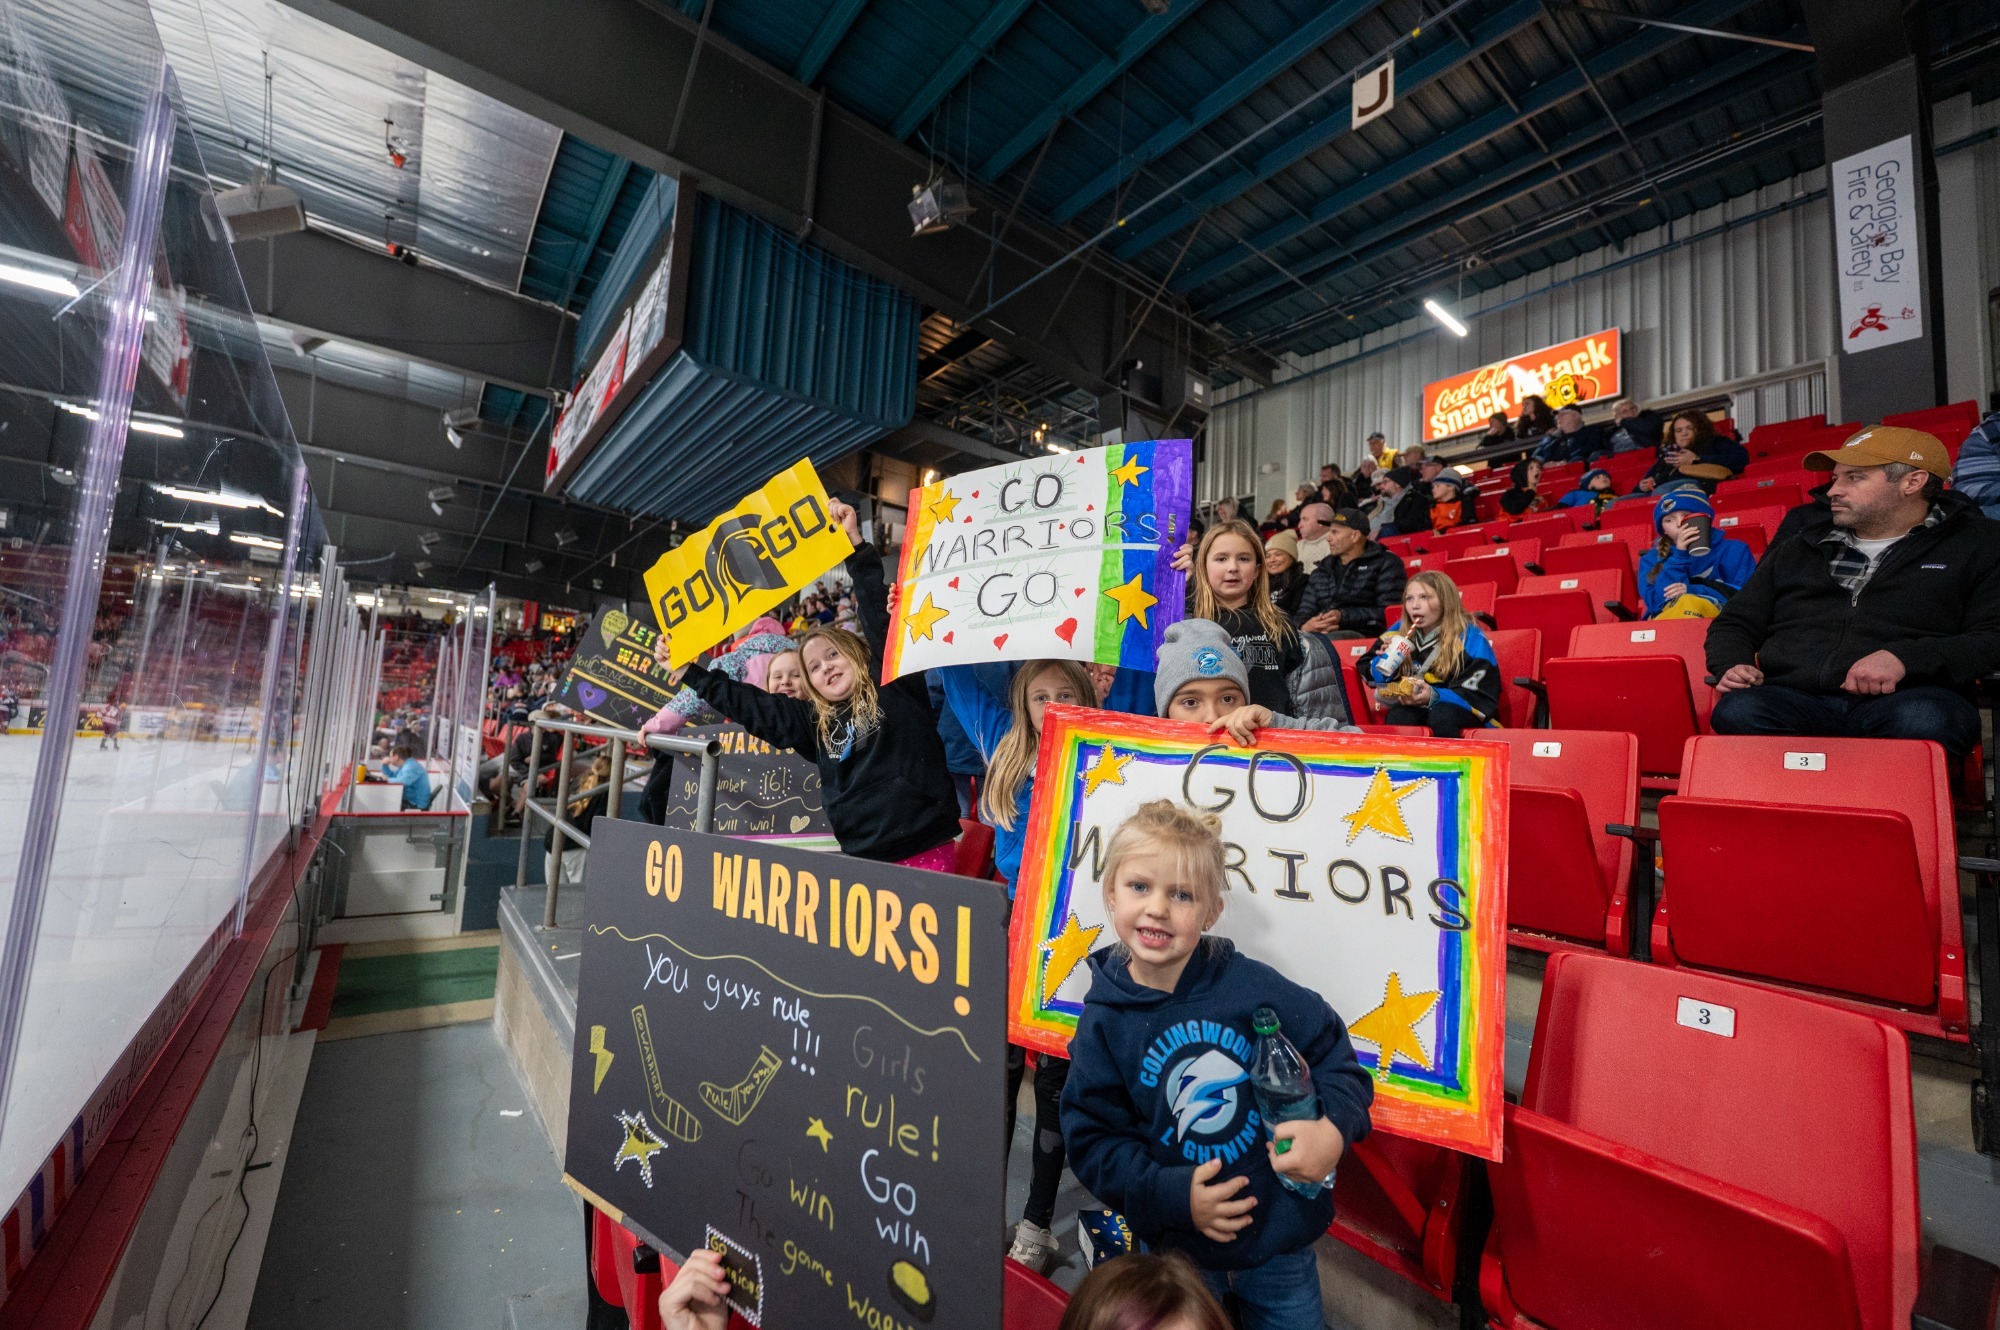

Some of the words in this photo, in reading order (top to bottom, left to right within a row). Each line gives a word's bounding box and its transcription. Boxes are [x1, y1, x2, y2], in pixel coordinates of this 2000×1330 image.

[1357, 67, 1388, 118] J
[1848, 165, 1871, 200] Fire
[1875, 159, 1900, 248] Georgian
[1850, 203, 1873, 220] &
[1846, 222, 1874, 277] Safety
[1874, 249, 1904, 284] Bay
[1430, 387, 1510, 439] Snack
[999, 472, 1064, 514] GO
[660, 569, 715, 629] GO
[761, 495, 826, 558] GO
[977, 571, 1059, 618] GO
[628, 619, 656, 647] LET
[1543, 745, 1550, 754] 4
[1799, 756, 1809, 766] 3
[1181, 743, 1313, 823] GO
[718, 816, 738, 831] will
[645, 840, 683, 902] GO
[1067, 820, 1472, 932] WRIORS
[703, 974, 761, 1010] guys
[1699, 1008, 1711, 1025] 3
[853, 1025, 926, 1095] Girls
[846, 1083, 939, 1161] rule!
[1160, 1109, 1260, 1164] LGHTNING
[790, 1178, 834, 1231] win
[876, 1217, 929, 1265] win
